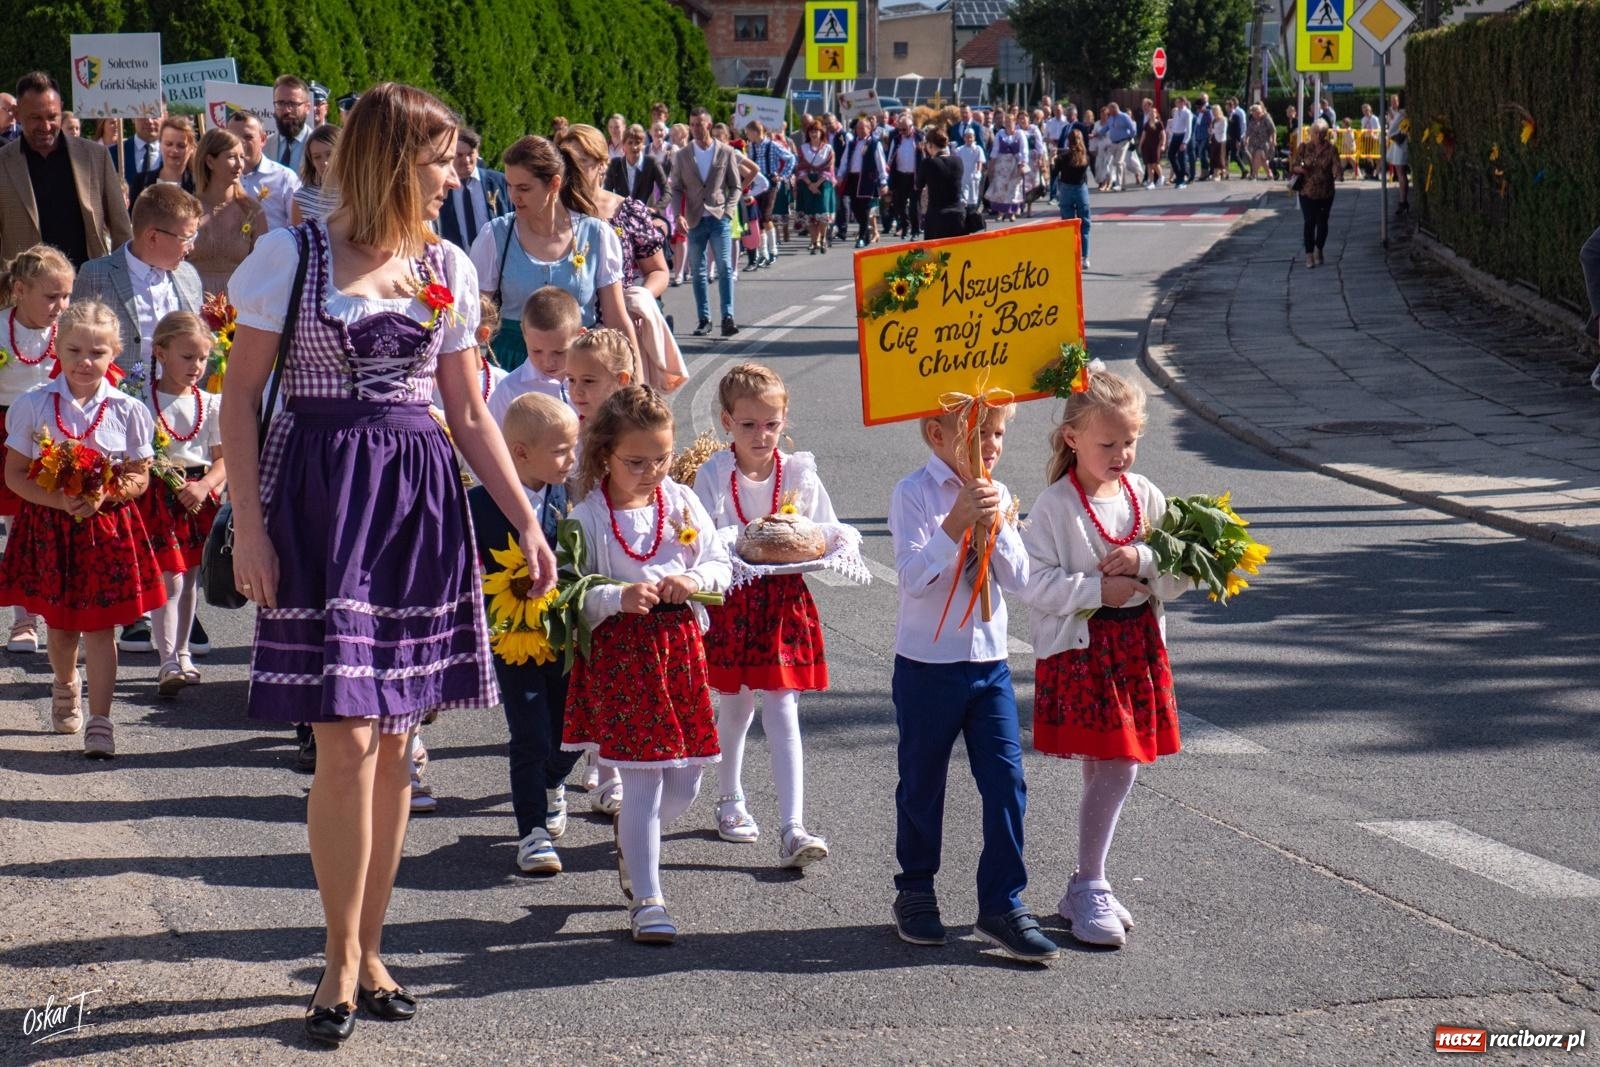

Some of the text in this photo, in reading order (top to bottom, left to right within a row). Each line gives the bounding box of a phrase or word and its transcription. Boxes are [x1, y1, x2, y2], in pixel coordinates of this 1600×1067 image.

[100, 76, 158, 93] Górki Śląskie
[168, 85, 206, 101] BABI
[940, 259, 1050, 308] Wszystko
[879, 300, 1060, 355] Cię mój Boże
[918, 341, 1009, 378] chwali
